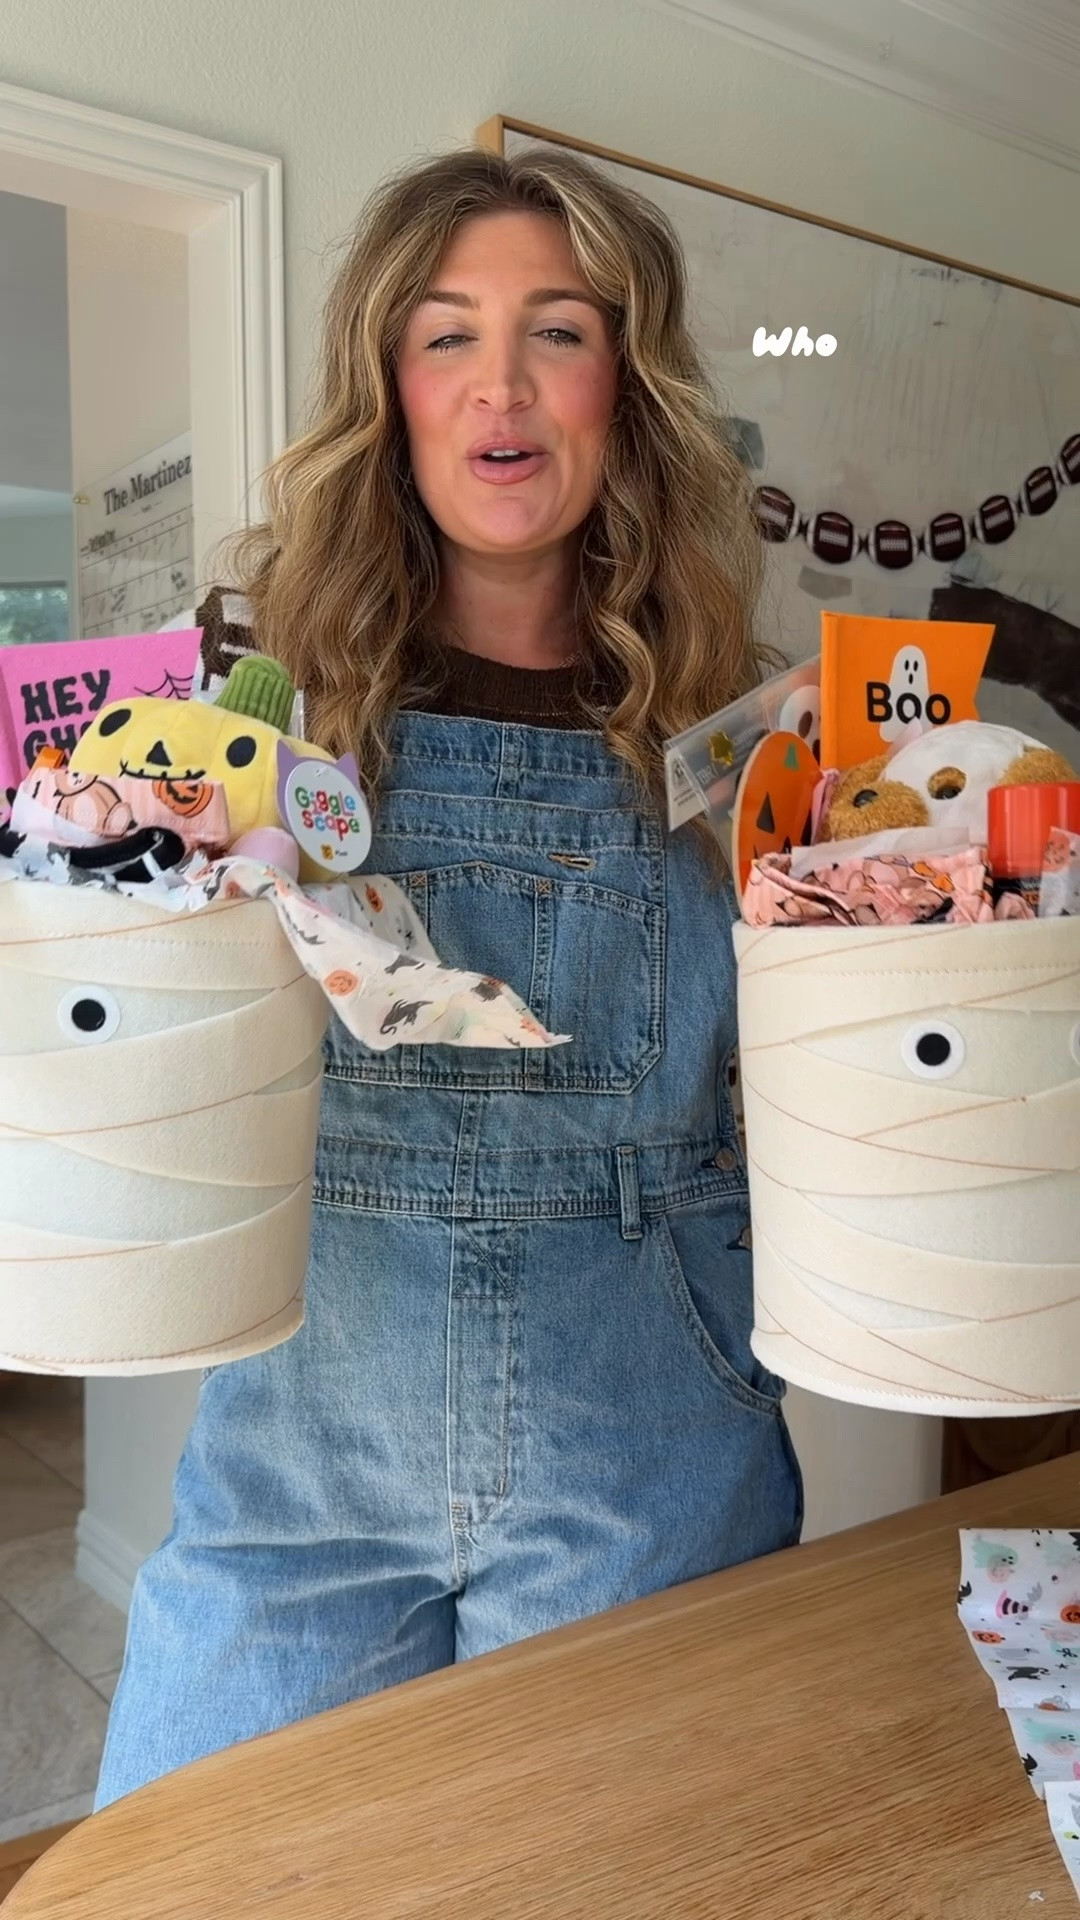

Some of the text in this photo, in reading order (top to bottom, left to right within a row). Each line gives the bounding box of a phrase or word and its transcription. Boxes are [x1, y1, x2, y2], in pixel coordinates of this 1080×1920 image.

[104, 454, 192, 516] The Martinez
[21, 669, 110, 725] HEY
[866, 681, 952, 725] Boo
[23, 721, 94, 770] GH
[295, 786, 356, 816] Giggle
[302, 810, 360, 841] scope
